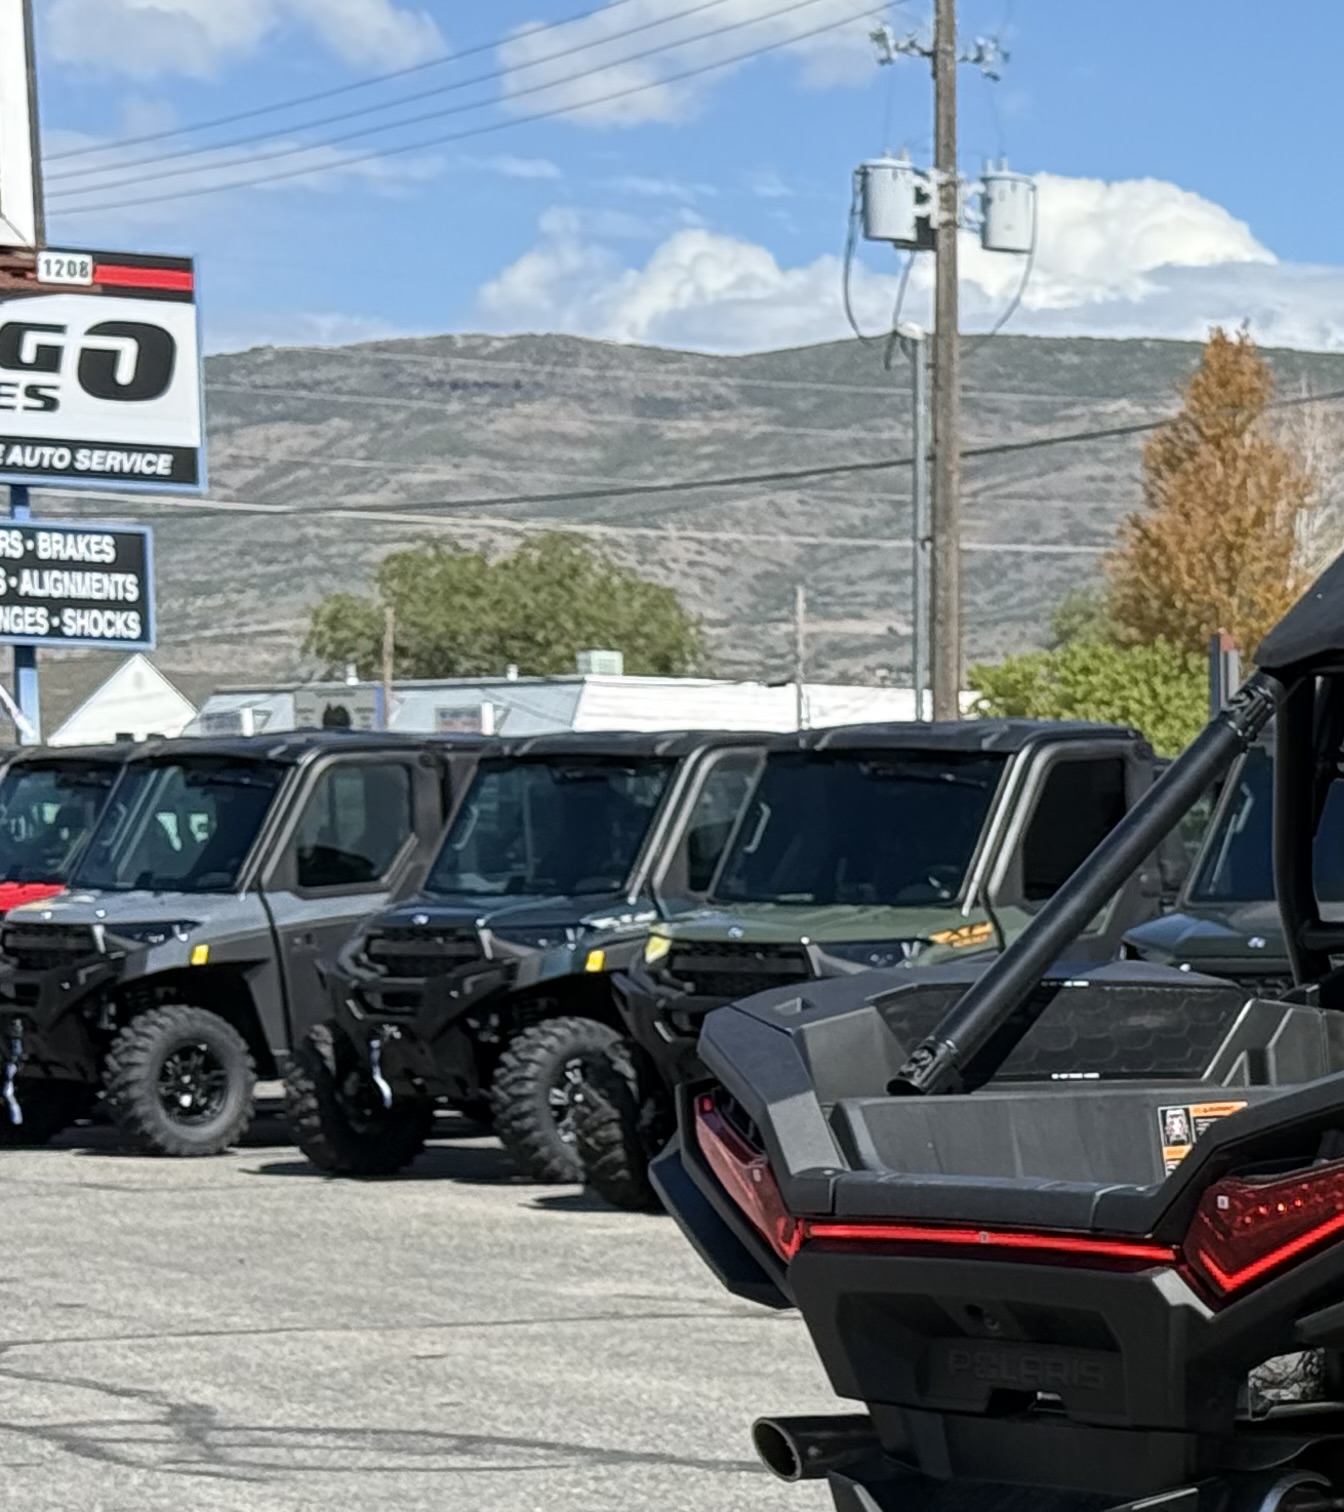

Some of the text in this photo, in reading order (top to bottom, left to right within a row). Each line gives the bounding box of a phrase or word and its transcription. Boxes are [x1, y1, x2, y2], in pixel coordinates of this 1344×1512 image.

[43, 258, 90, 279] 1208
[5, 444, 72, 470] AUTO
[74, 449, 173, 476] SERVICE
[36, 531, 116, 564] BRAKES
[19, 568, 140, 602] ALIGNMENTS
[62, 607, 142, 639] SHOCKS
